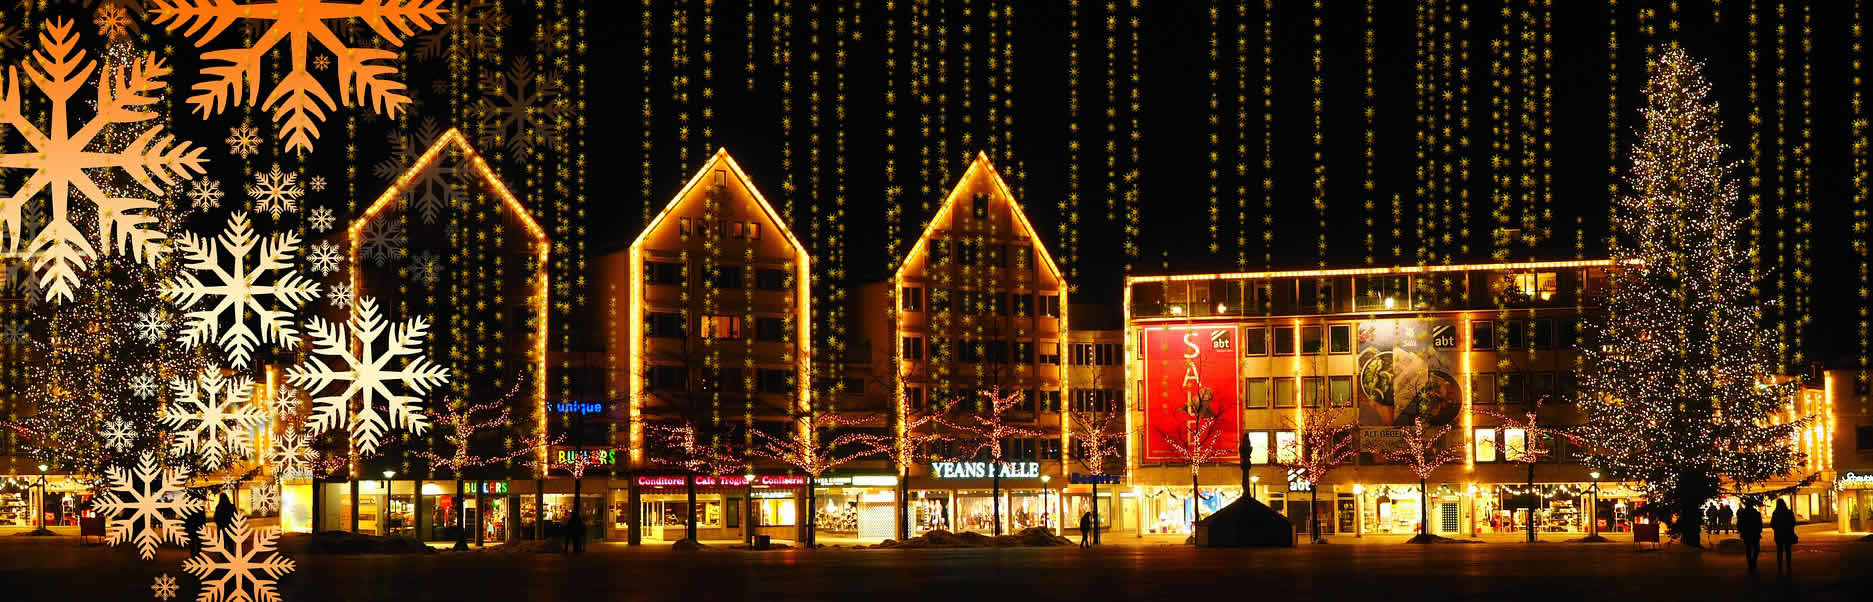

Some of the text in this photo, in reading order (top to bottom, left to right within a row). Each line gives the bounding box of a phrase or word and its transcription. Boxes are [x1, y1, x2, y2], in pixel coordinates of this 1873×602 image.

[1213, 338, 1230, 348] abt
[1435, 336, 1454, 347] abt
[1183, 332, 1202, 445] SALE
[556, 400, 602, 416] unique
[558, 450, 616, 465] BULERS
[931, 461, 985, 478] YEANS
[464, 481, 508, 495] BULERS
